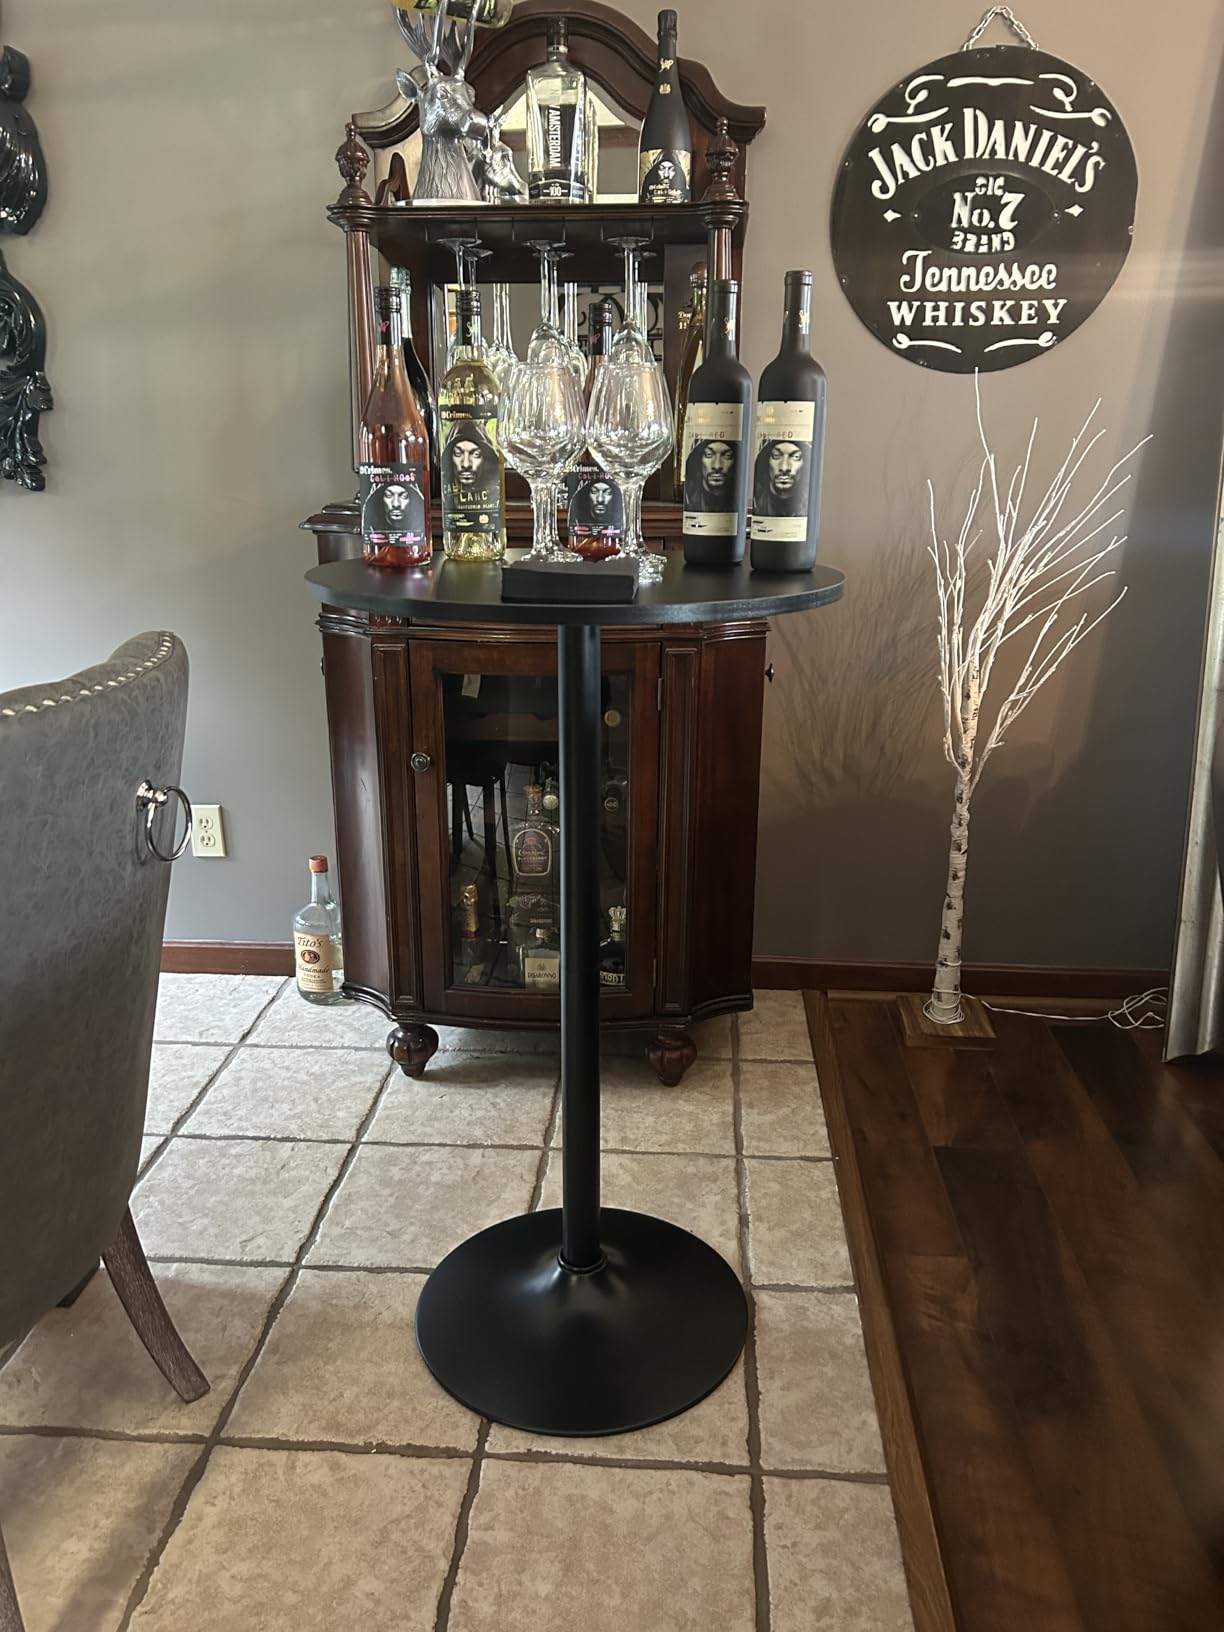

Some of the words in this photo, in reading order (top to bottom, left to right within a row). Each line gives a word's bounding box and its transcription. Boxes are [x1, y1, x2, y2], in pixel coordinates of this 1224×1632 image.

[549, 111, 561, 168] AMSTERDAM
[868, 123, 958, 200] JACK
[962, 107, 1107, 194] DANIEL'S
[549, 186, 562, 196] 100
[951, 191, 996, 229] No.
[999, 192, 1026, 231] 7
[950, 230, 1016, 253] BRAND
[900, 249, 1057, 293] Tennessee
[887, 298, 1068, 326] WHISKEY
[297, 937, 323, 948] Tito's
[298, 964, 329, 973] Handmade
